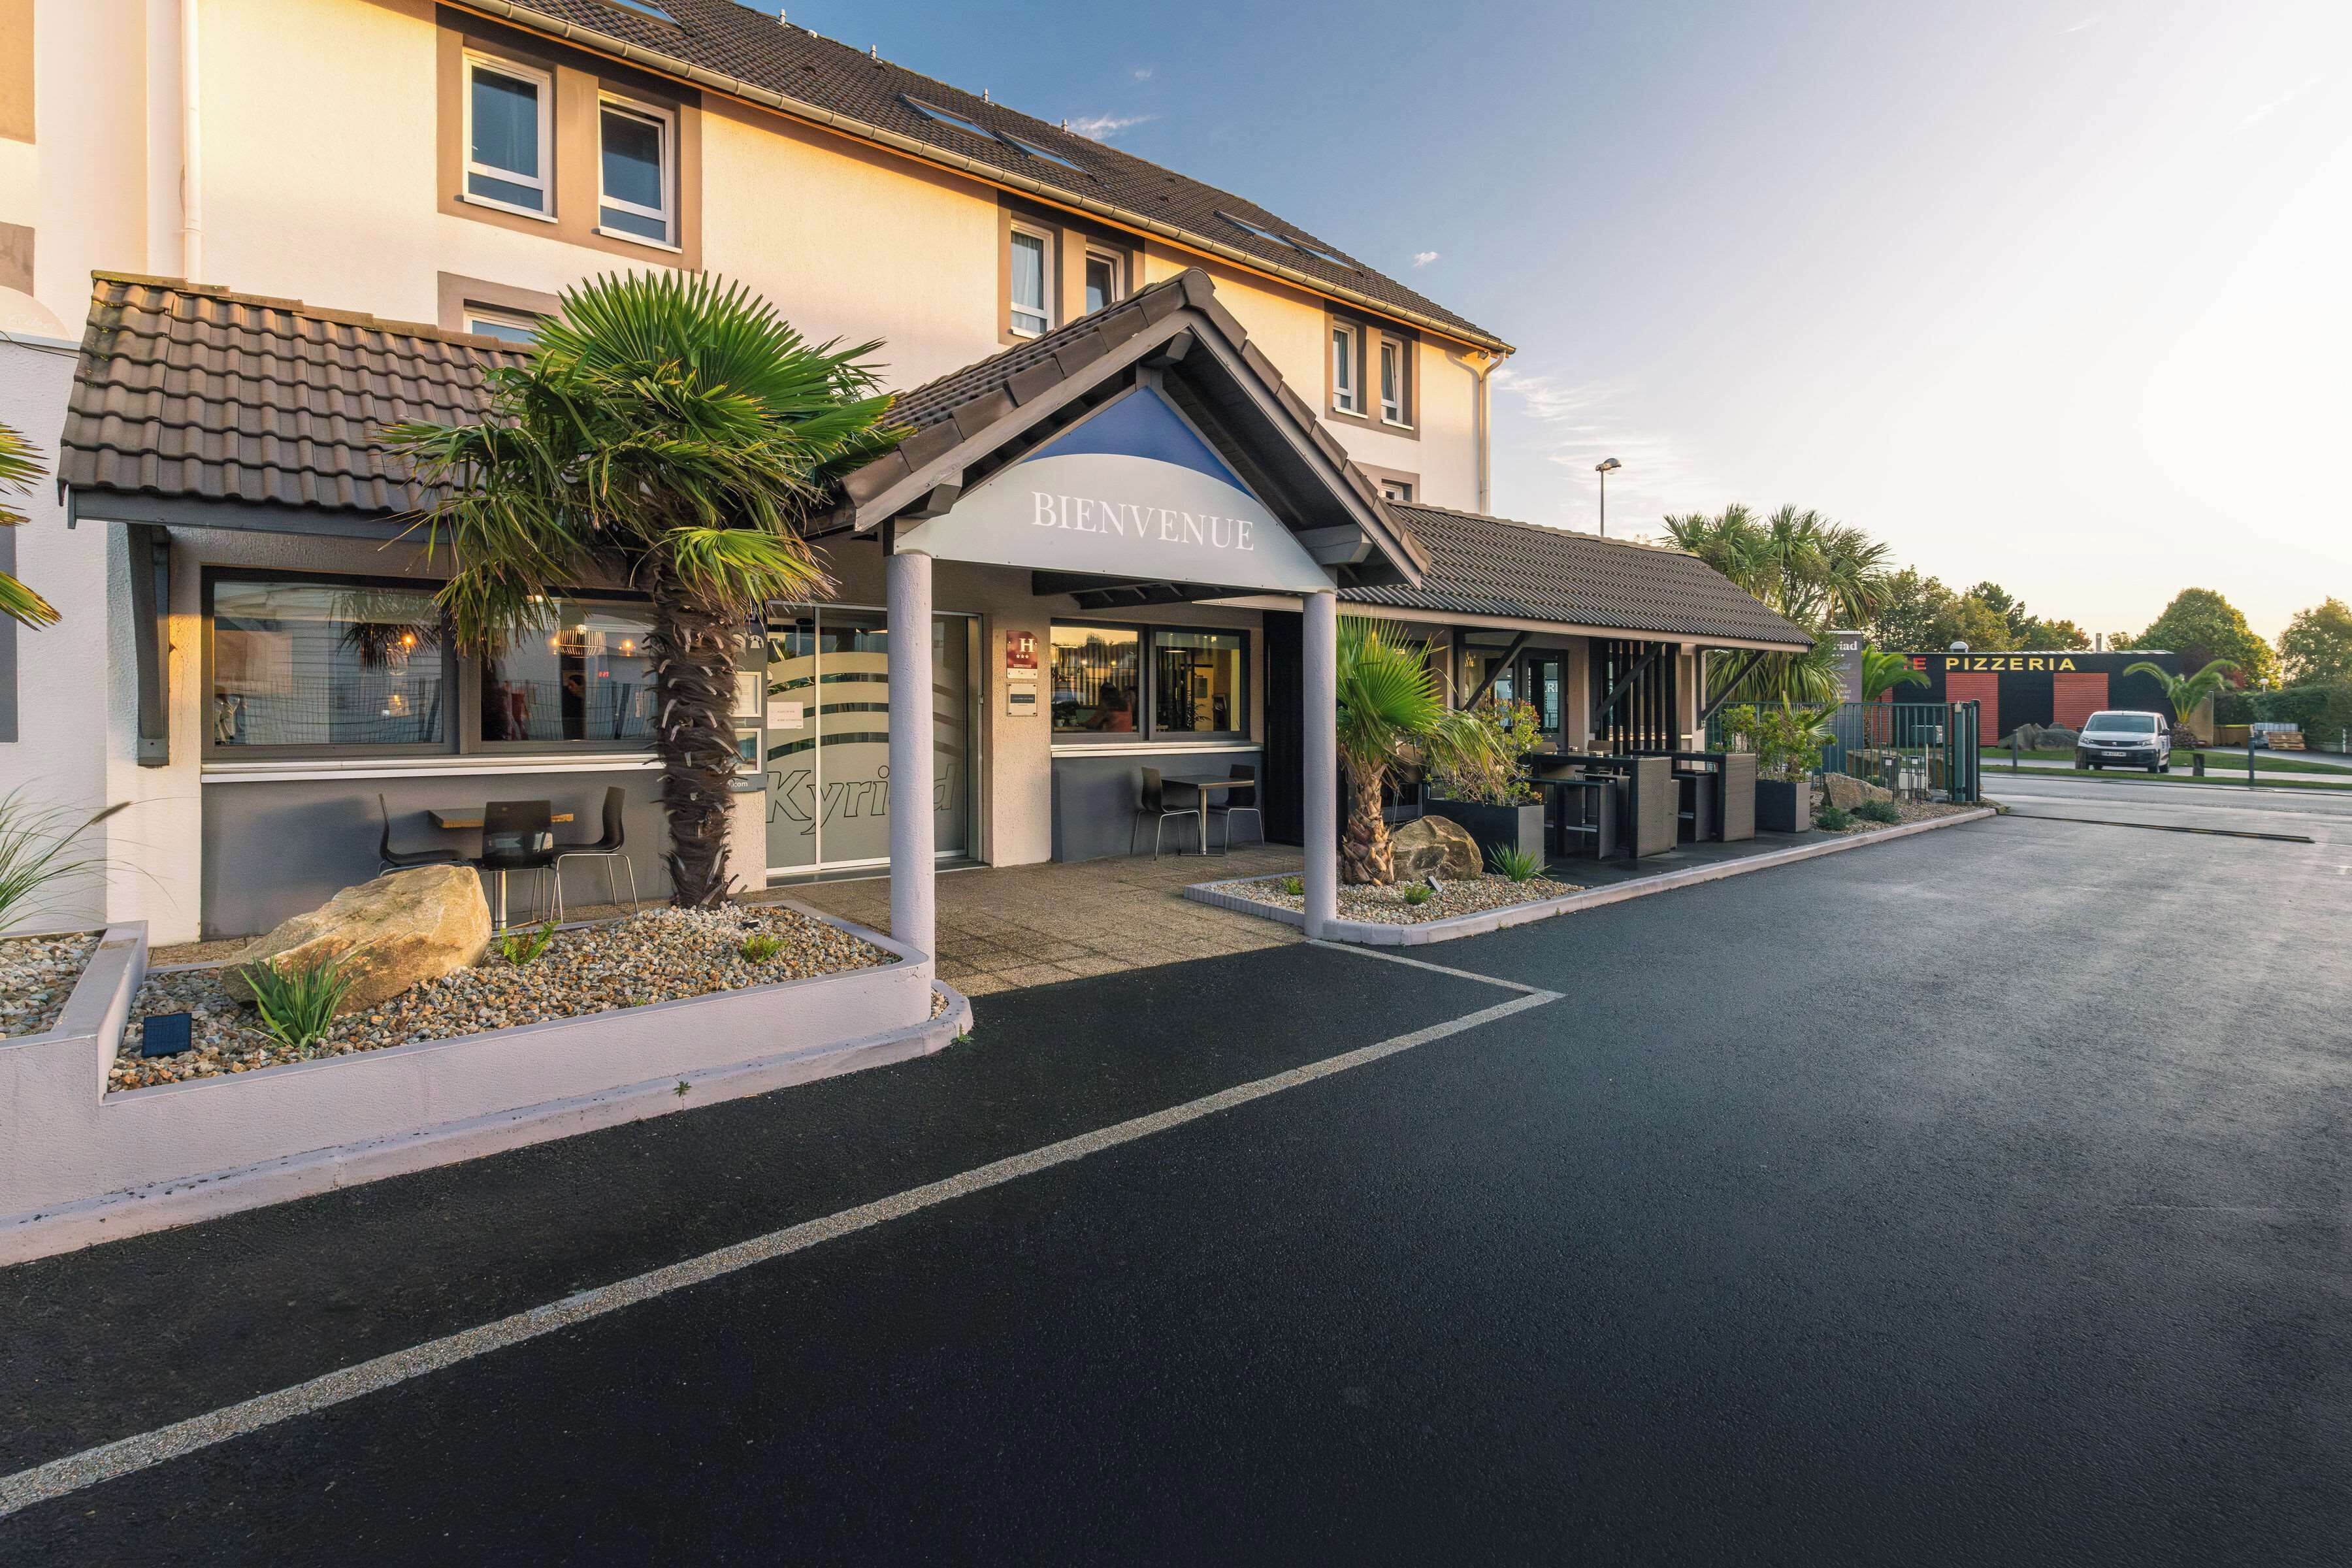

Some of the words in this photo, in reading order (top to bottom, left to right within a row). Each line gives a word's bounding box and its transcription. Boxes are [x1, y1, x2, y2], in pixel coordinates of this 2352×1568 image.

[1031, 491, 1254, 551] BIENVENUE
[1019, 638, 1035, 652] H
[1946, 658, 2076, 670] PIZZERIA
[766, 763, 958, 835] Kyrid
